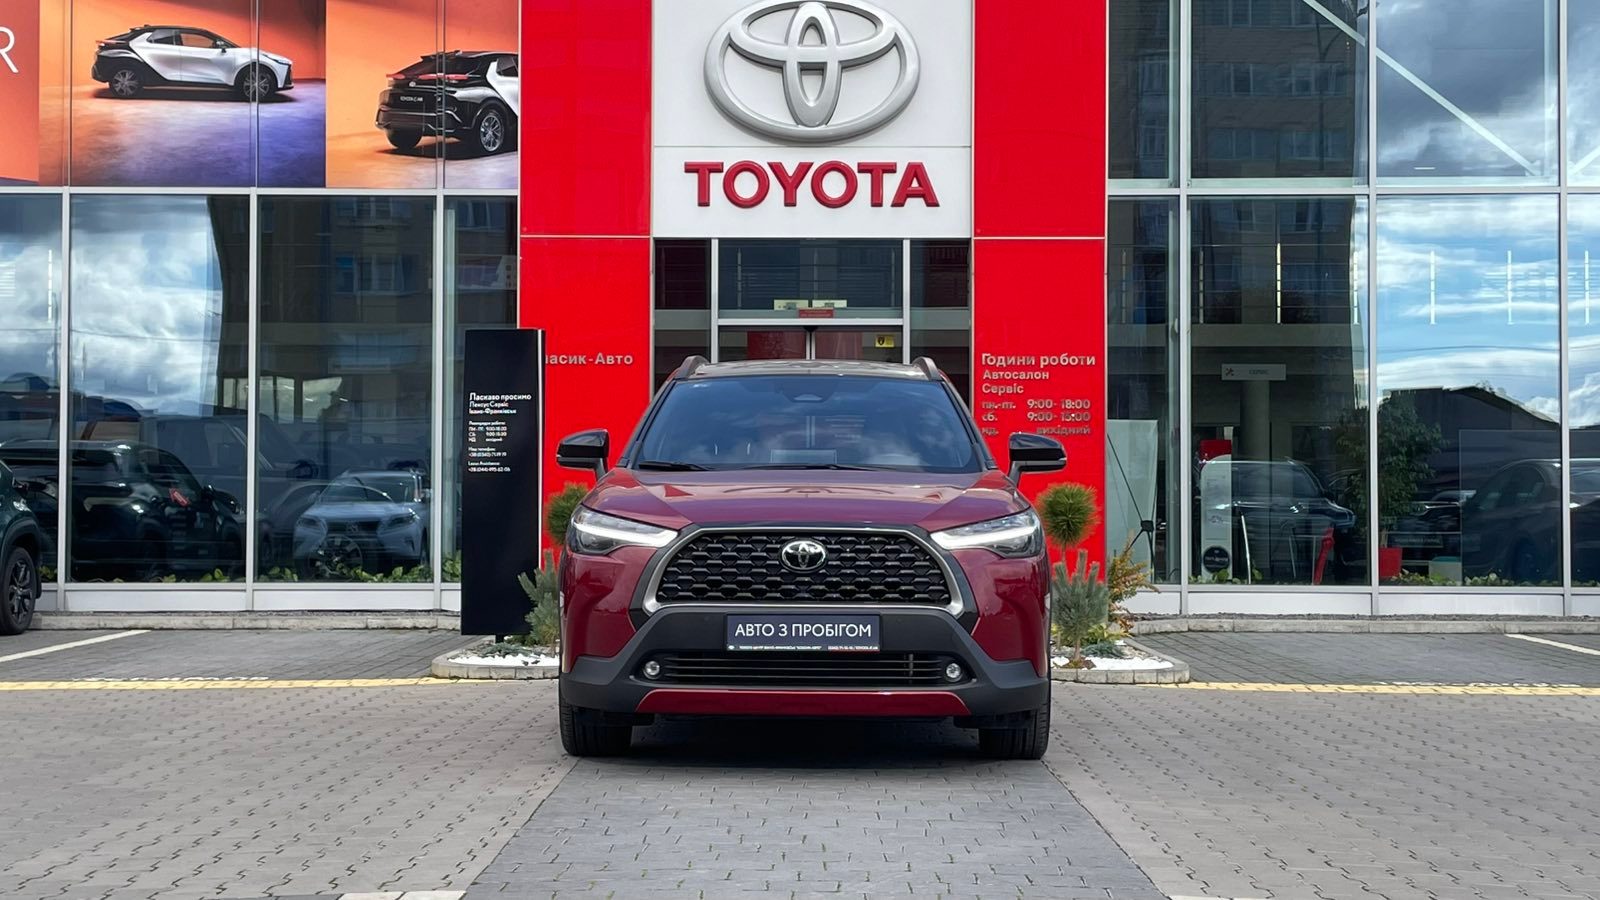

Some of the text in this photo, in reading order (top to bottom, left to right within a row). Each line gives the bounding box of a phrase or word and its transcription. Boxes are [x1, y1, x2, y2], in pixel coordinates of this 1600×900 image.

[684, 160, 940, 209] TOYOTA
[545, 352, 633, 365] асик-Авто
[981, 353, 1096, 368] Години роботи
[983, 370, 1049, 380] Автосалон
[982, 383, 1024, 396] Сервіс
[469, 392, 532, 402] Ласкаво просимо
[735, 623, 872, 637] АВТО З ПРОБІГОМ
